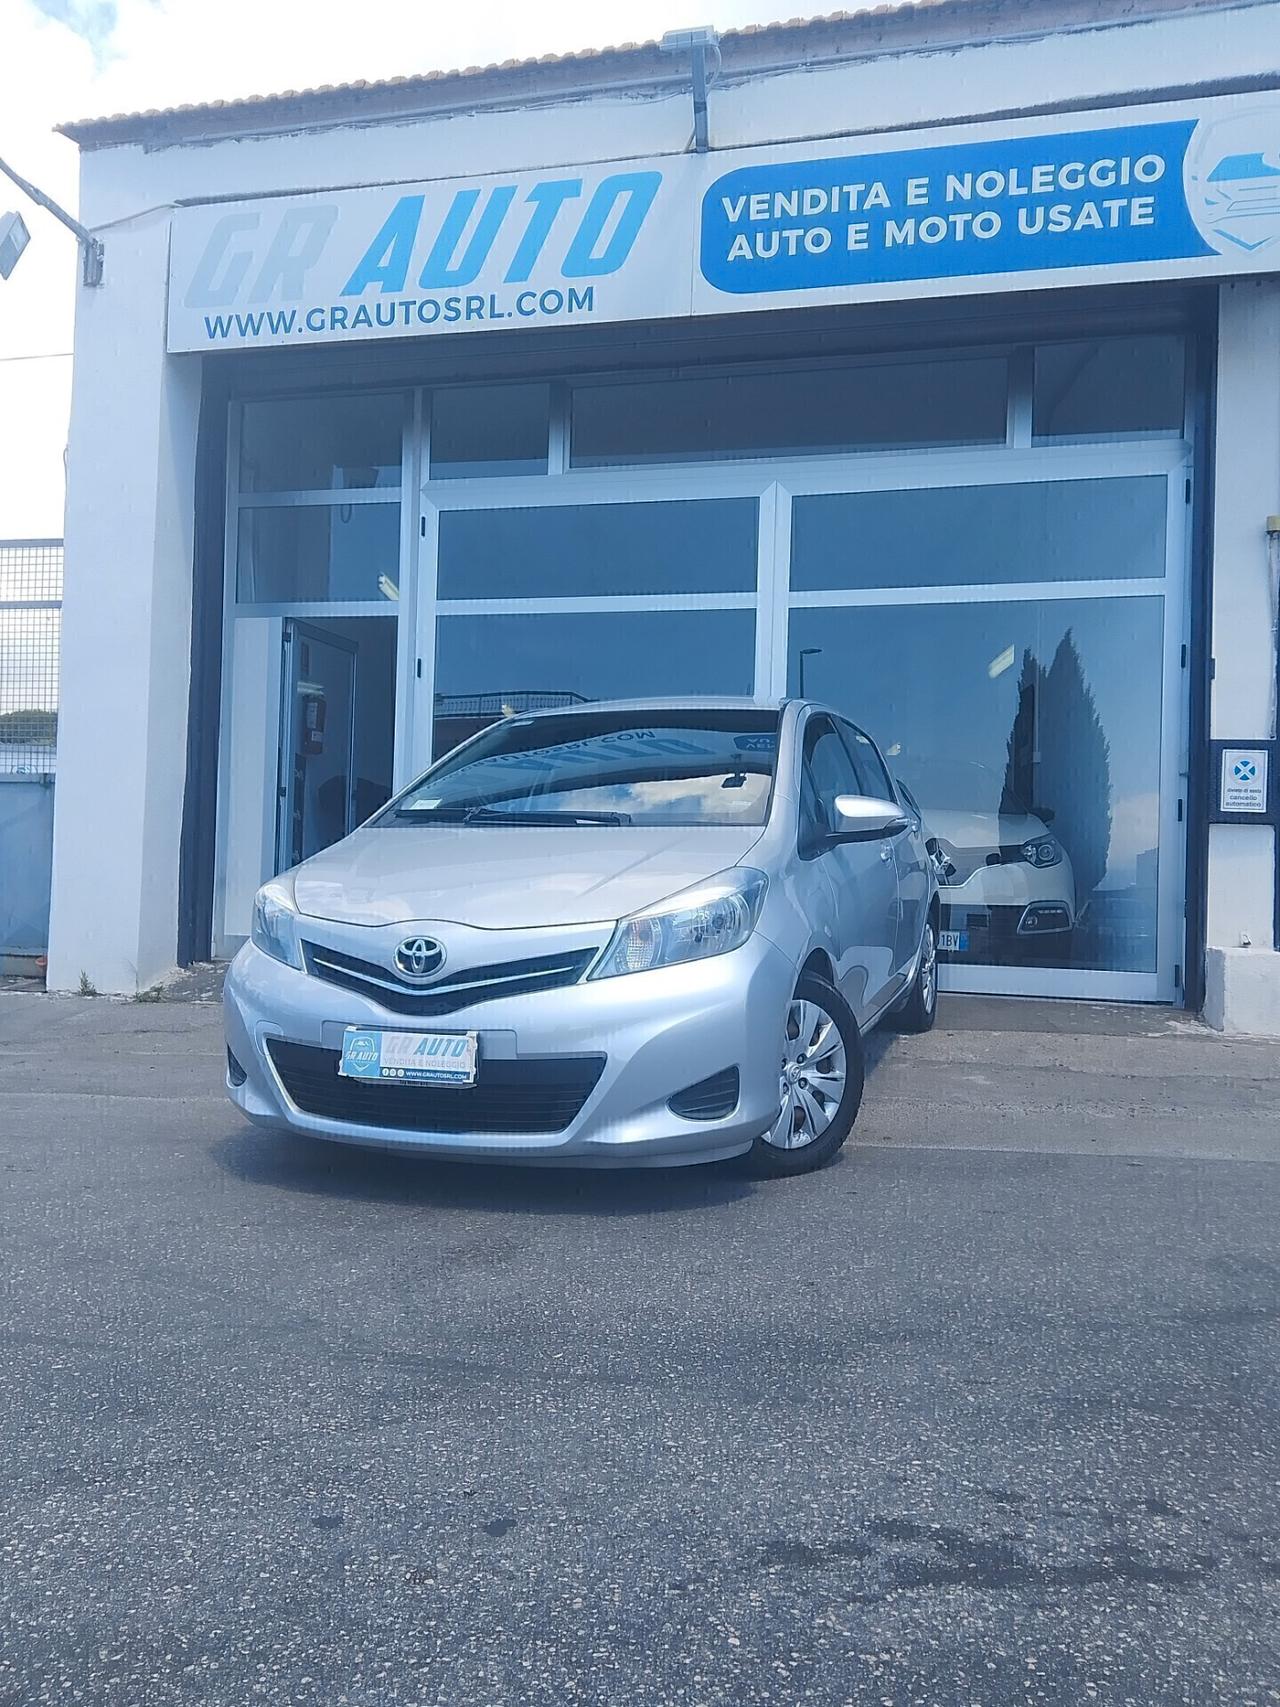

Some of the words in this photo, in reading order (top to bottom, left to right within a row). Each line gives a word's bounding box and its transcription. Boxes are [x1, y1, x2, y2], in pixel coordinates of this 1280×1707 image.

[722, 180, 891, 223] VENDITA
[907, 177, 930, 206] E
[946, 154, 1166, 202] NOLEGGIO
[184, 205, 339, 309] GR
[339, 170, 663, 297] AUTO
[727, 225, 832, 261] AUTO
[847, 221, 869, 251] E
[885, 212, 1002, 248] MOTO
[1018, 196, 1156, 235] USATE
[204, 286, 594, 339] WWW.GRAUTOSRL.COM
[940, 934, 959, 947] 1BV
[358, 1051, 379, 1062] AUTO
[413, 1038, 468, 1057] AUTO
